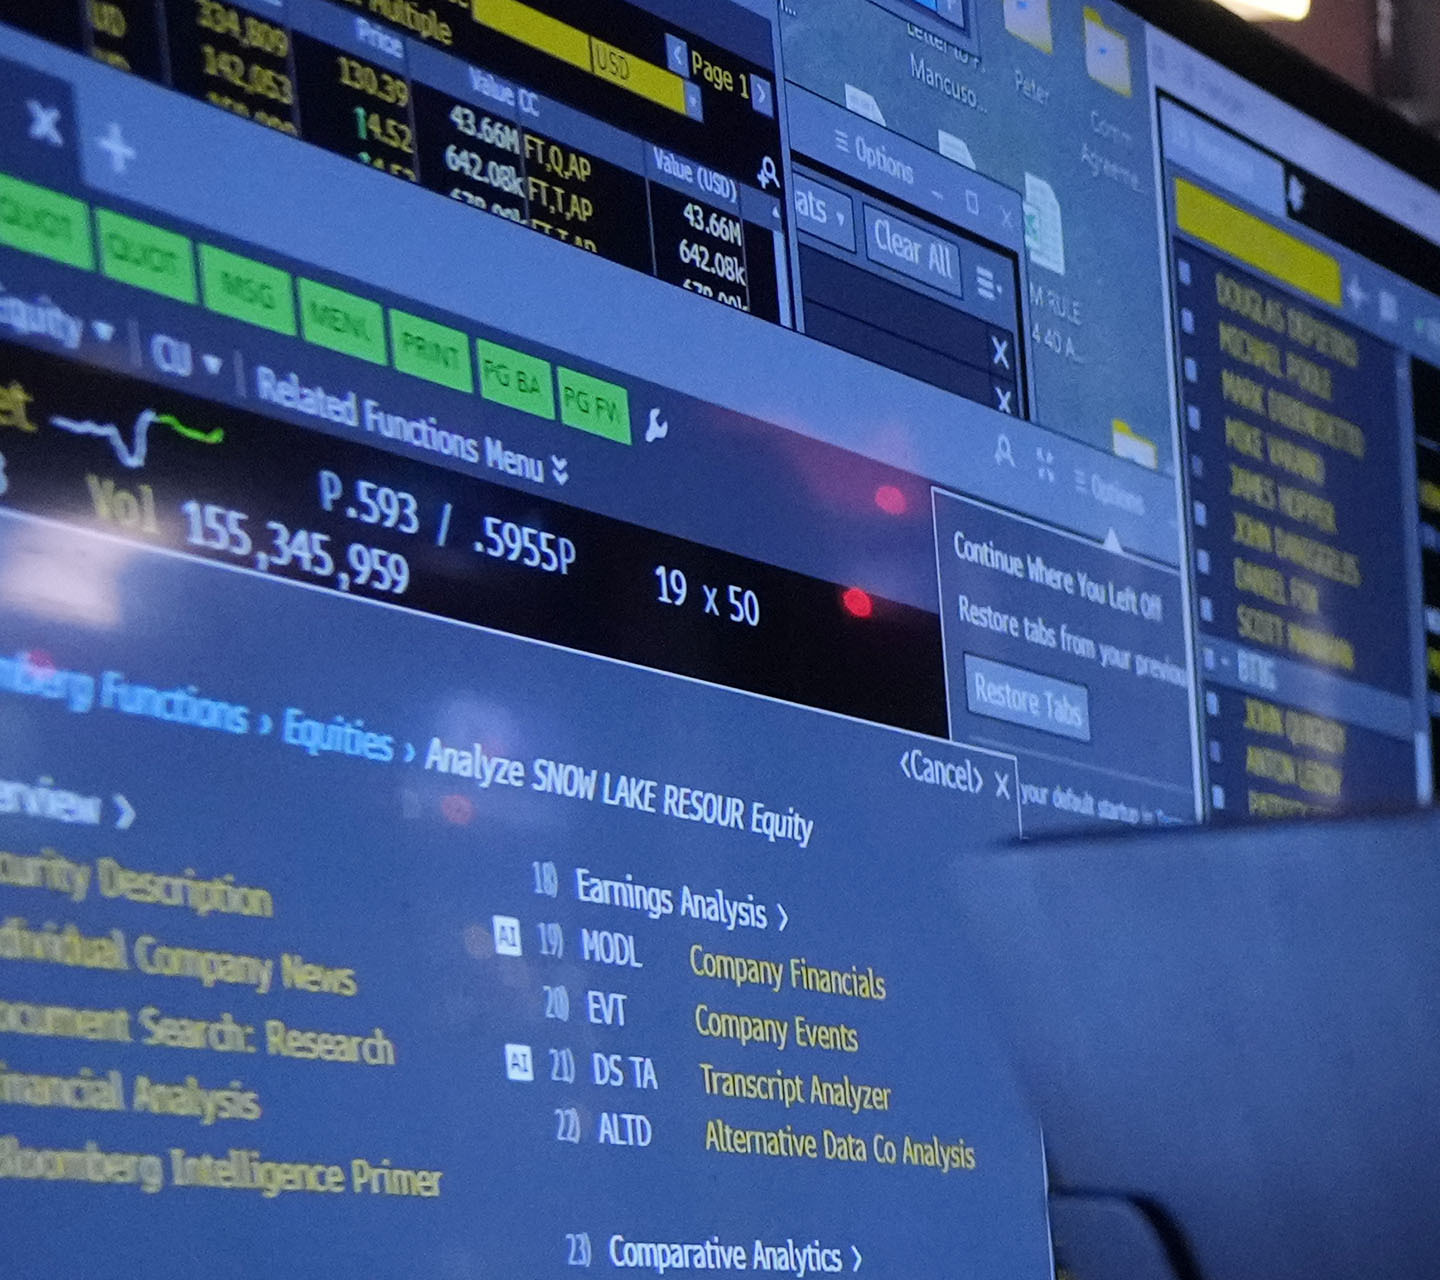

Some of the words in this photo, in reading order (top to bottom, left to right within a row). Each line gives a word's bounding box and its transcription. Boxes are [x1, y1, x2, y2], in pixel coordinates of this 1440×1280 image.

[469, 64, 515, 106] Value
[692, 50, 734, 95] Page
[739, 73, 750, 100] 1
[449, 104, 520, 156] 43.66M
[854, 135, 915, 185] Options
[445, 143, 526, 198] 642.08k
[653, 145, 695, 185] Value
[697, 169, 738, 204] (USD)
[683, 201, 742, 248] 43.66M
[873, 217, 921, 266] Clear
[928, 242, 954, 280] All
[678, 238, 747, 288] 642.08k
[255, 363, 360, 428] Related
[361, 397, 481, 465] Functions
[484, 434, 546, 484] Menu
[182, 499, 411, 595] 155,345,959
[953, 529, 1025, 578] Continue
[1027, 554, 1075, 595] Where
[1076, 570, 1106, 606] You
[654, 563, 688, 607] 19
[727, 582, 761, 628] 50
[958, 593, 1020, 639] Restore
[1023, 615, 1057, 649] tabs
[1060, 623, 1096, 661] from
[1099, 642, 1132, 674] your
[974, 671, 1041, 719] Restore
[1044, 689, 1084, 728] Tabs
[100, 670, 250, 737] Functions
[282, 707, 395, 763] Equities
[424, 736, 526, 790] Analyze
[532, 758, 597, 803] SNOW
[602, 771, 657, 814] LAKE
[662, 784, 745, 829] RESOUR
[750, 801, 815, 849] Equity
[97, 856, 274, 918] Description
[576, 868, 674, 922] Earnings
[680, 883, 768, 933] Analysis
[133, 934, 273, 995] Company
[281, 952, 358, 998] News
[581, 927, 643, 970] MODL
[688, 944, 785, 994] Company
[790, 958, 887, 1002] Financials
[138, 1006, 257, 1054] Search:
[265, 1019, 396, 1066] Research
[587, 988, 627, 1028] EVT
[695, 1004, 788, 1051] Company
[795, 1015, 859, 1054] Events
[133, 1074, 262, 1126] Analysis
[592, 1052, 624, 1089] DS
[631, 1054, 658, 1091] TA
[699, 1062, 806, 1108] Transcript
[809, 1079, 892, 1113] Analyzer
[598, 1111, 653, 1148] ALTD
[705, 1118, 817, 1162] Alternative
[823, 1128, 867, 1164] Data
[872, 1136, 897, 1166] Co
[902, 1137, 976, 1173] Analysis
[170, 1147, 346, 1199] Intelligence
[351, 1158, 443, 1198] Primer
[608, 1233, 746, 1275] Comparative
[751, 1237, 843, 1279] Analytics
